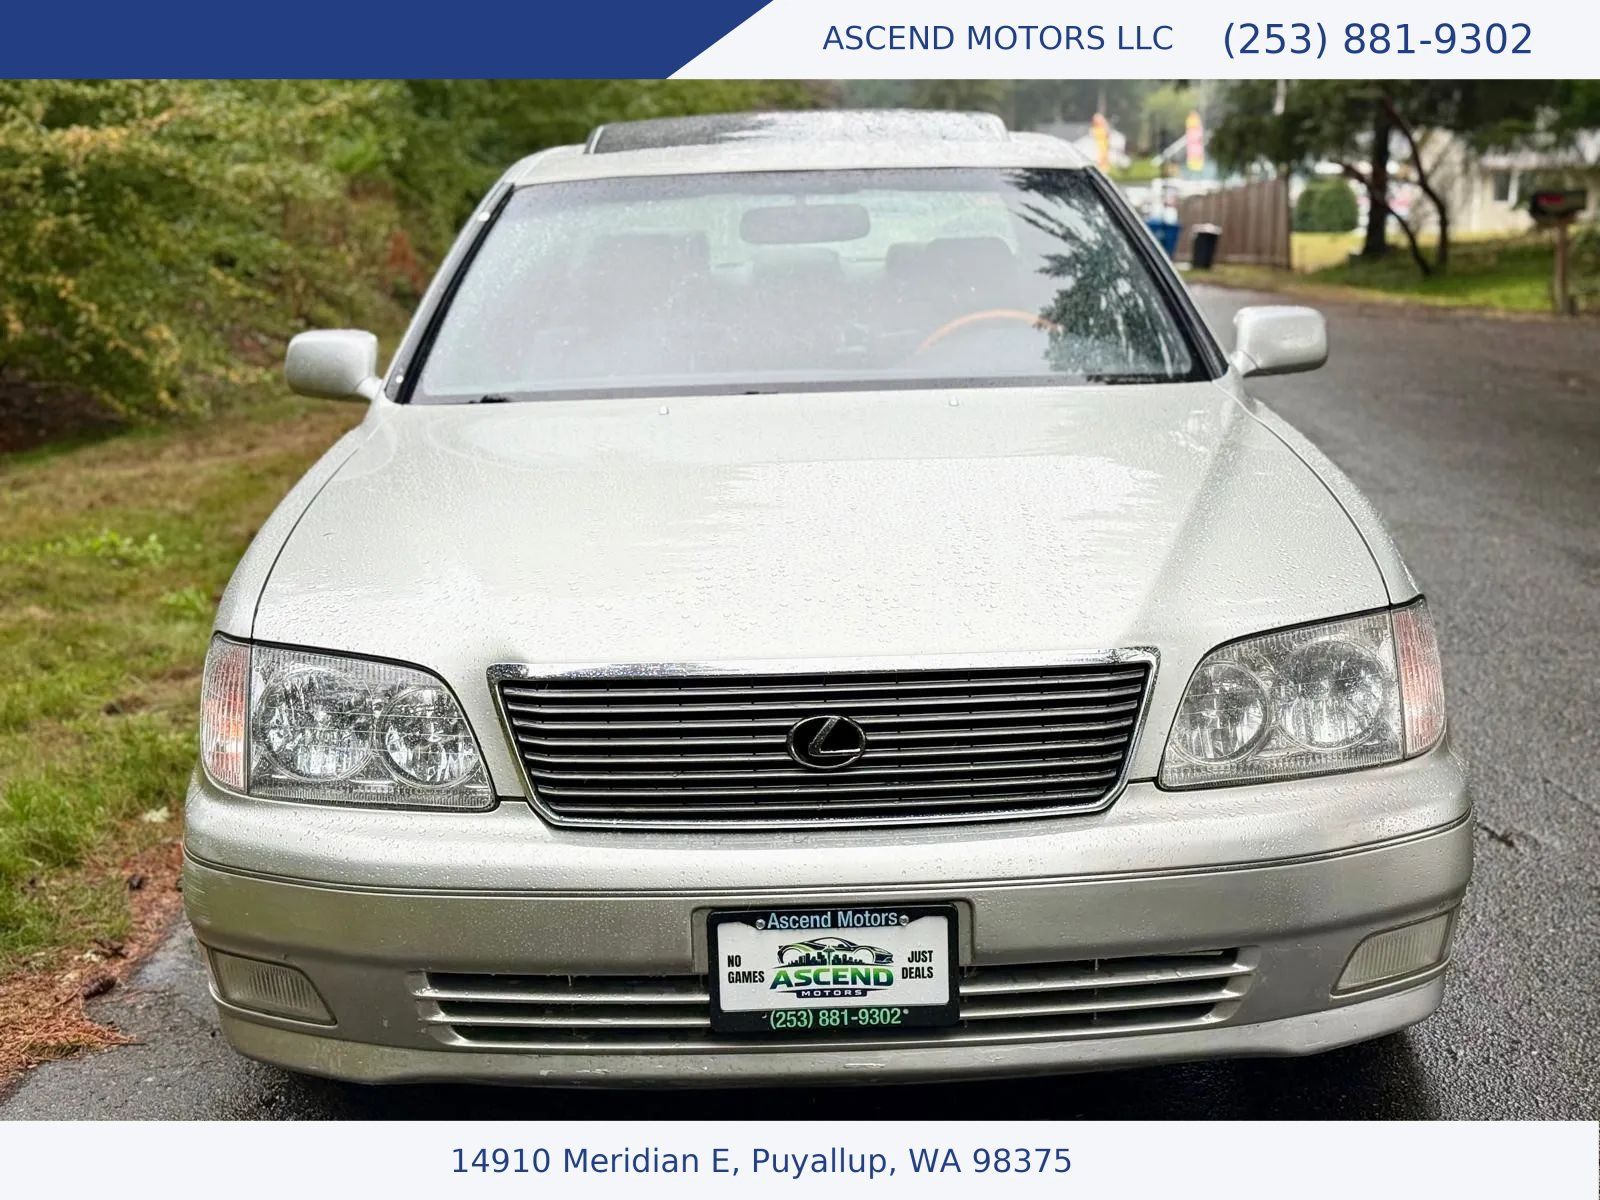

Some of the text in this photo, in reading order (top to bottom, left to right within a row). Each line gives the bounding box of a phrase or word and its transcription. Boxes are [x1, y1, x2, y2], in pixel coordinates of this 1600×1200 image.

[767, 911, 898, 929] Ascend Motors
[727, 955, 742, 968] NO
[907, 950, 934, 964] JUST
[727, 970, 765, 984] GAMES
[769, 967, 894, 989] ASCEND
[901, 966, 934, 980] DEALS
[801, 989, 863, 998] MOTORS
[770, 1008, 902, 1030] (253) 881-9302
